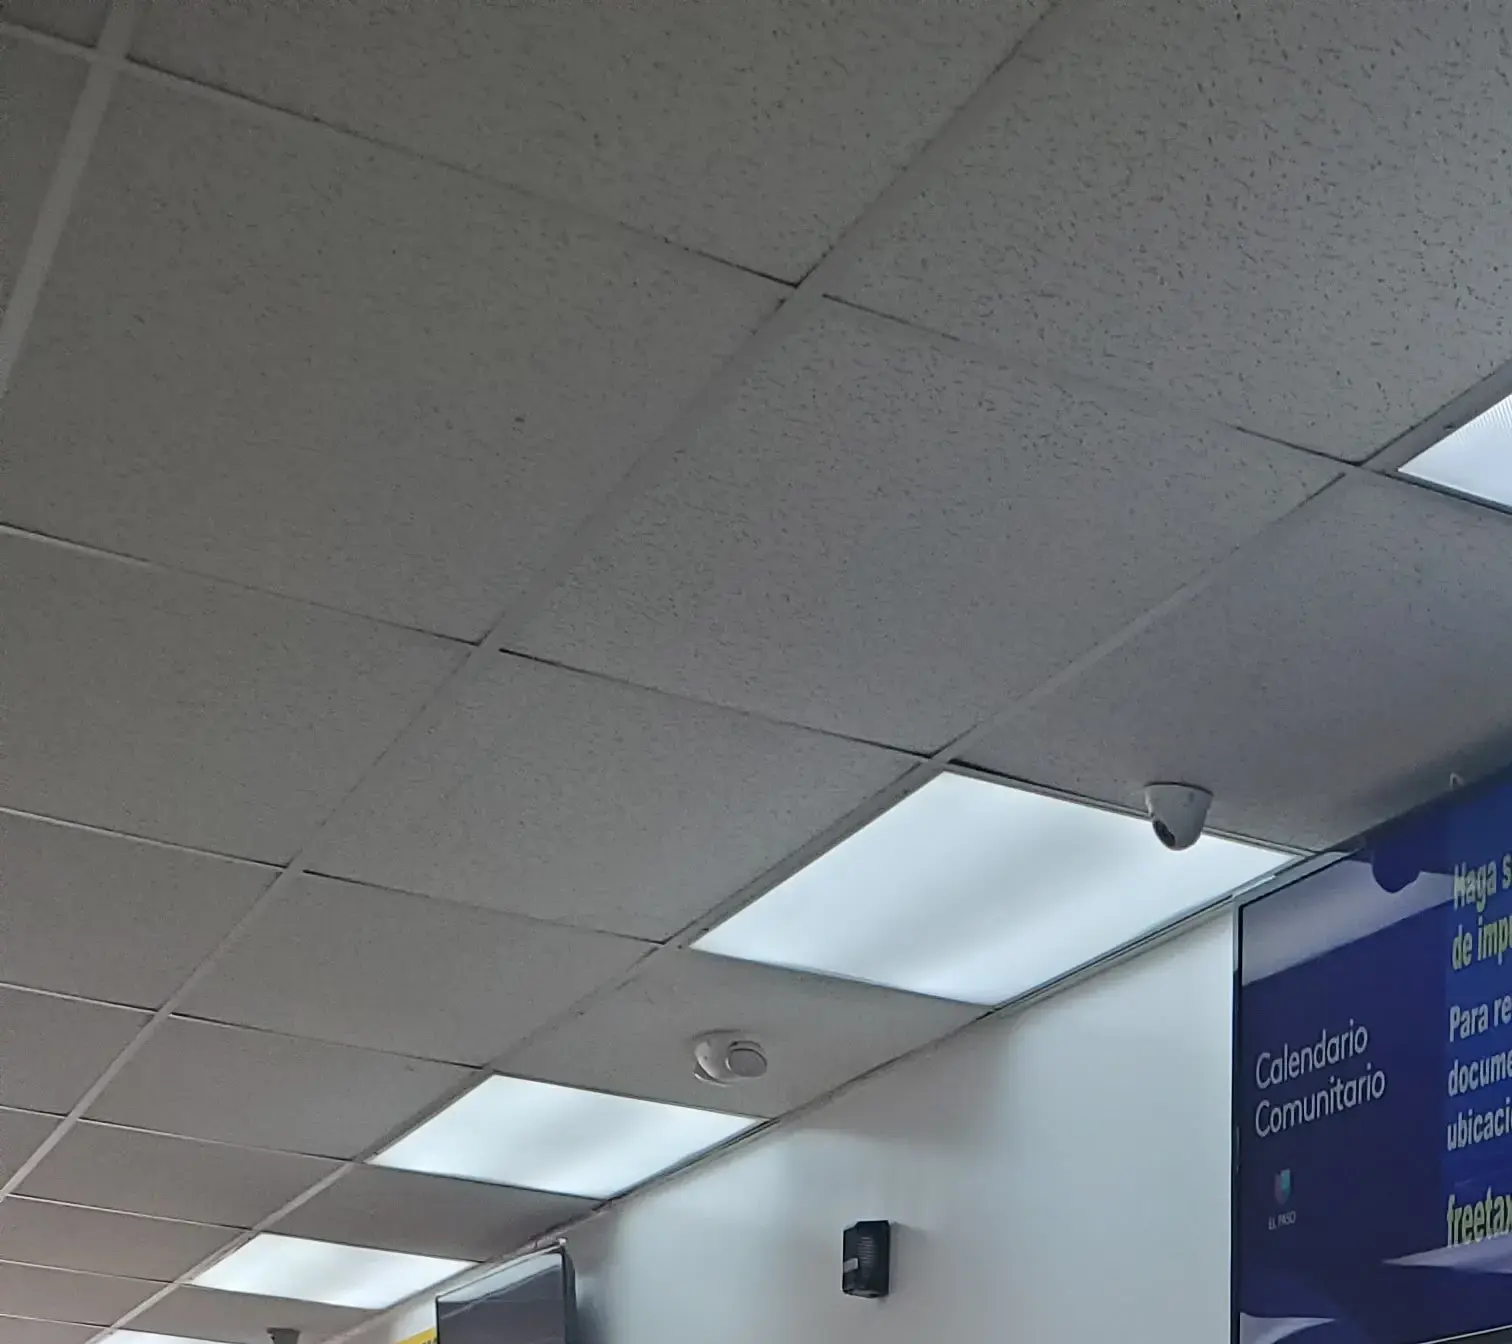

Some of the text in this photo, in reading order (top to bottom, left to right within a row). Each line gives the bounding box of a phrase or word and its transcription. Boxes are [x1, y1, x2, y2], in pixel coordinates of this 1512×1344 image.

[1454, 861, 1497, 912] Haga
[1452, 924, 1472, 970] de
[1450, 1004, 1488, 1042] Para
[1255, 1018, 1368, 1089] Calendario
[1255, 1062, 1386, 1137] Comunitario
